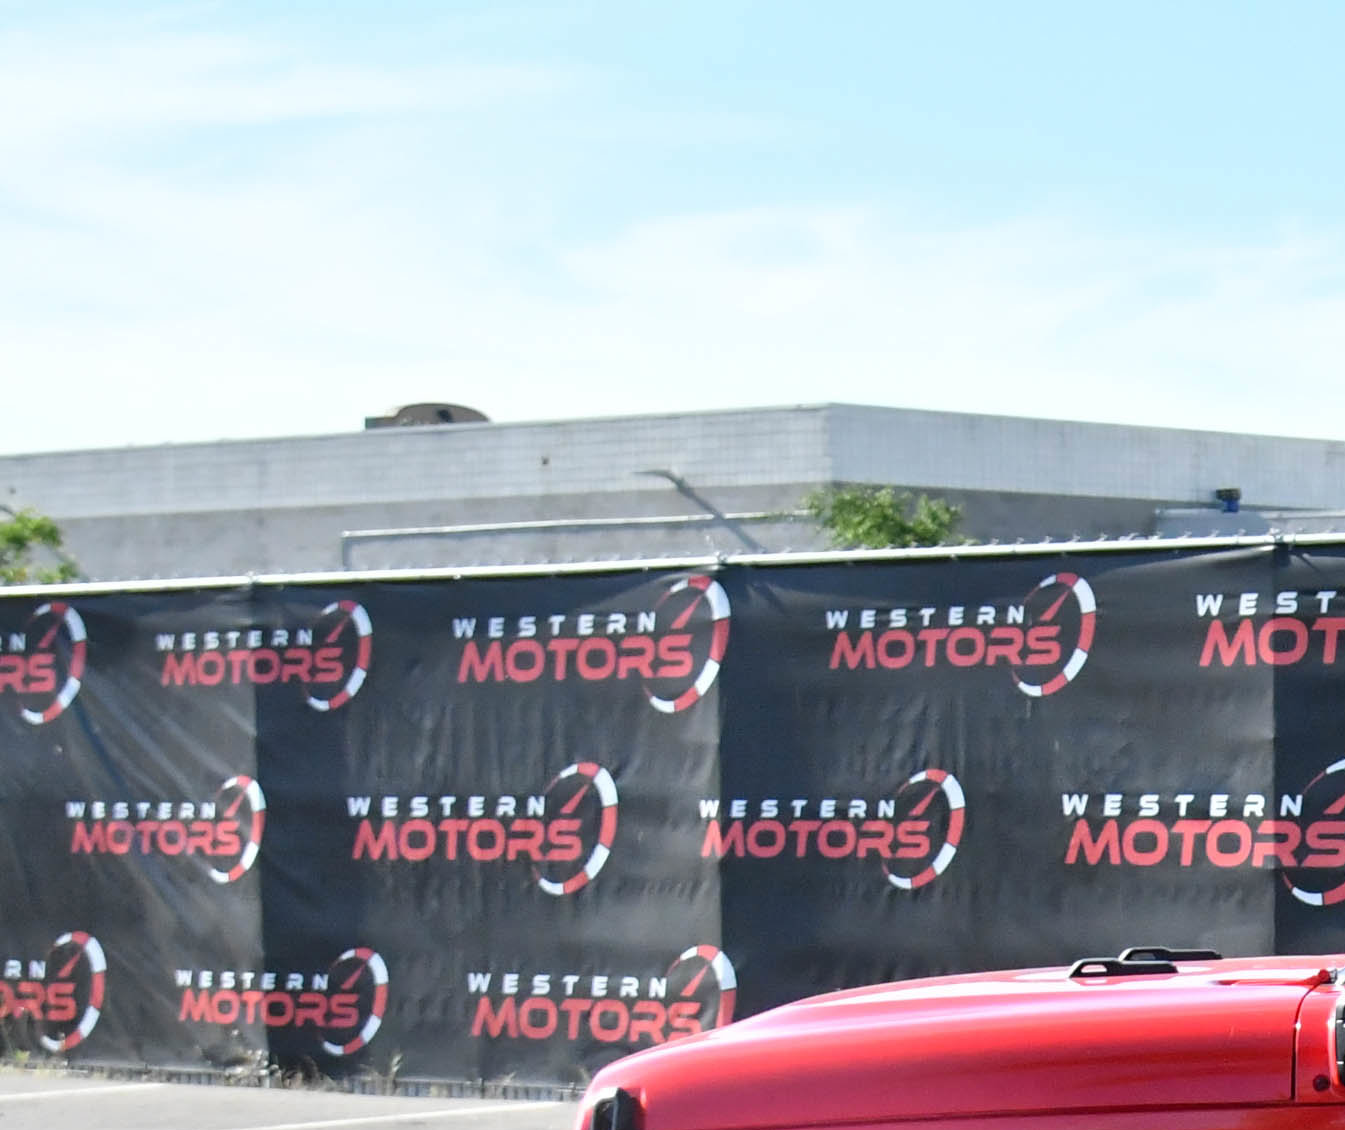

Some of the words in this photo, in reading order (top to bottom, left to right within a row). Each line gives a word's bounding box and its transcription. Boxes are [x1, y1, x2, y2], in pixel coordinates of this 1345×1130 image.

[454, 612, 656, 638] WESTERN
[826, 606, 1025, 629] WESTERN
[157, 629, 312, 650] WESTERN
[830, 626, 1061, 669] MOTORS
[162, 648, 343, 686] MOTORS
[458, 635, 693, 682] MOTORS
[66, 801, 216, 820] WESTERN
[348, 796, 545, 817] WESTERN
[699, 799, 895, 818] WESTERN
[1062, 793, 1303, 817] WESTERN
[71, 820, 240, 856] MOTORS
[353, 818, 582, 862] MOTORS
[702, 819, 930, 859] MOTORS
[175, 968, 328, 990] WESTERN
[467, 972, 667, 998] WESTERN
[179, 987, 358, 1027] MOTORS
[471, 996, 702, 1043] MOTORS
